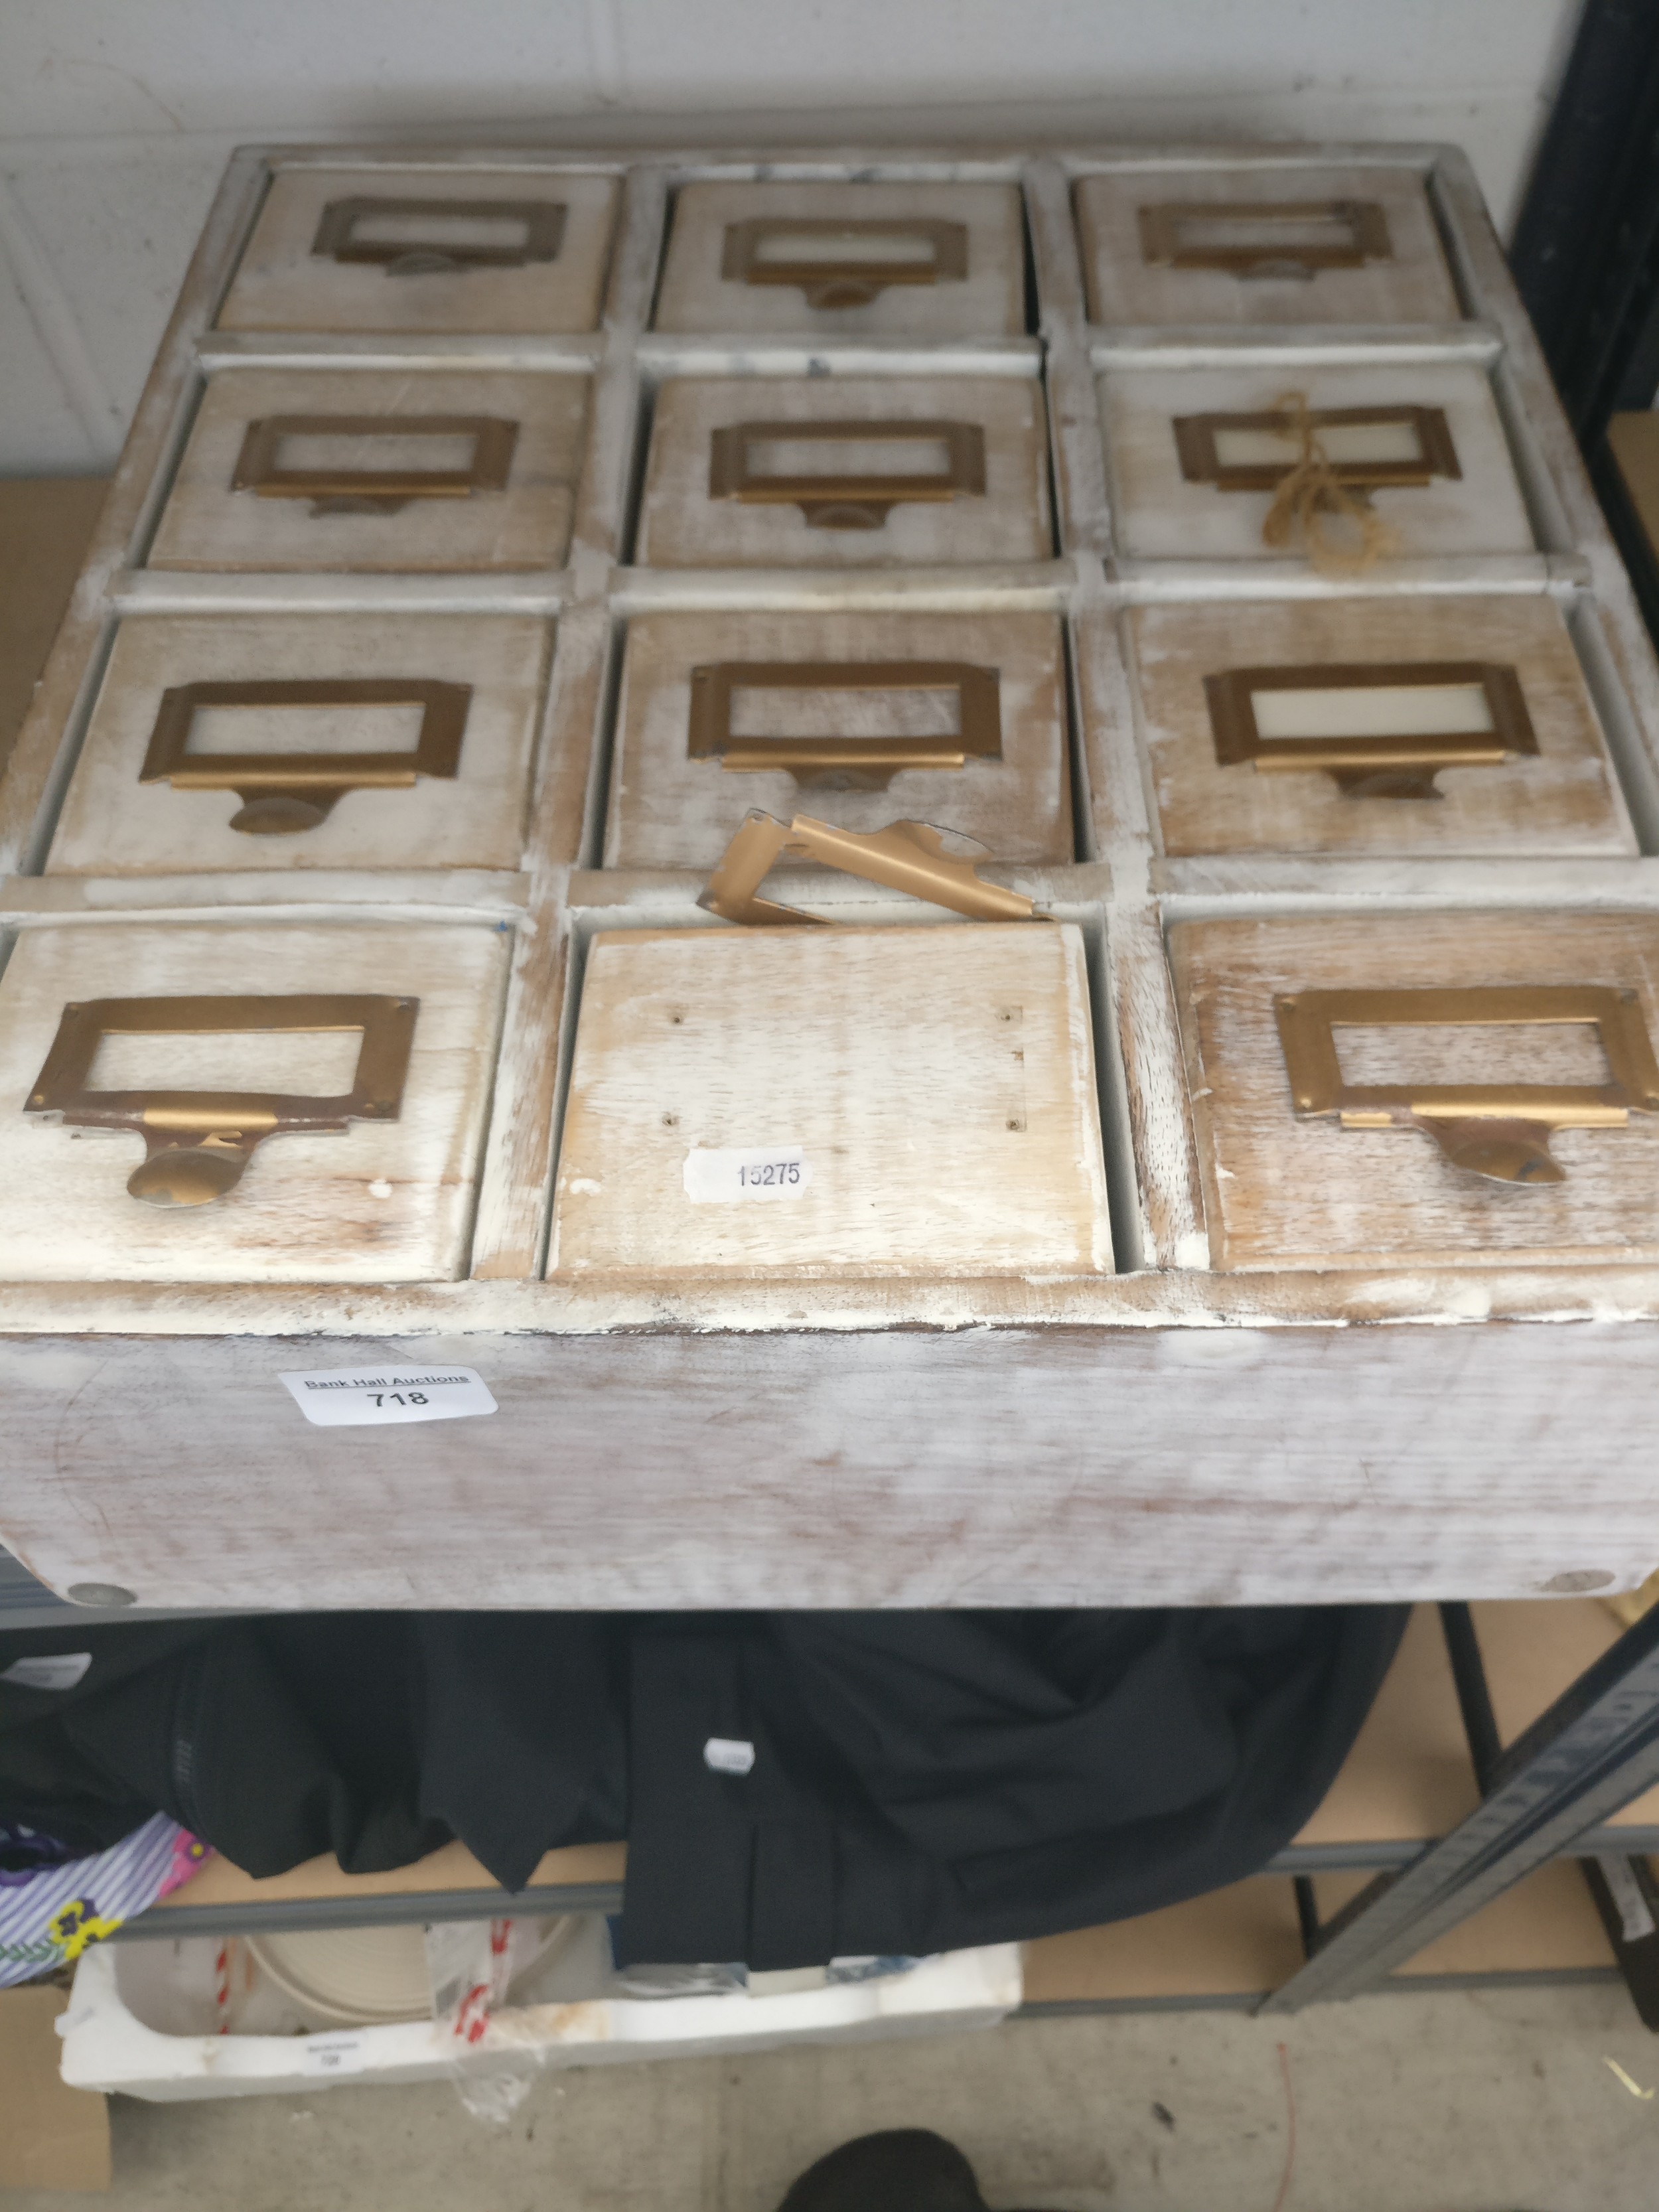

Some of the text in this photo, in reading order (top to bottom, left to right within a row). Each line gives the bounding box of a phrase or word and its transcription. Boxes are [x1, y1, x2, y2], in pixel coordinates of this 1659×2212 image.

[737, 1162, 800, 1187] 15275
[304, 1374, 470, 1388] Bank Hall Auctions
[367, 1392, 429, 1408] 718
